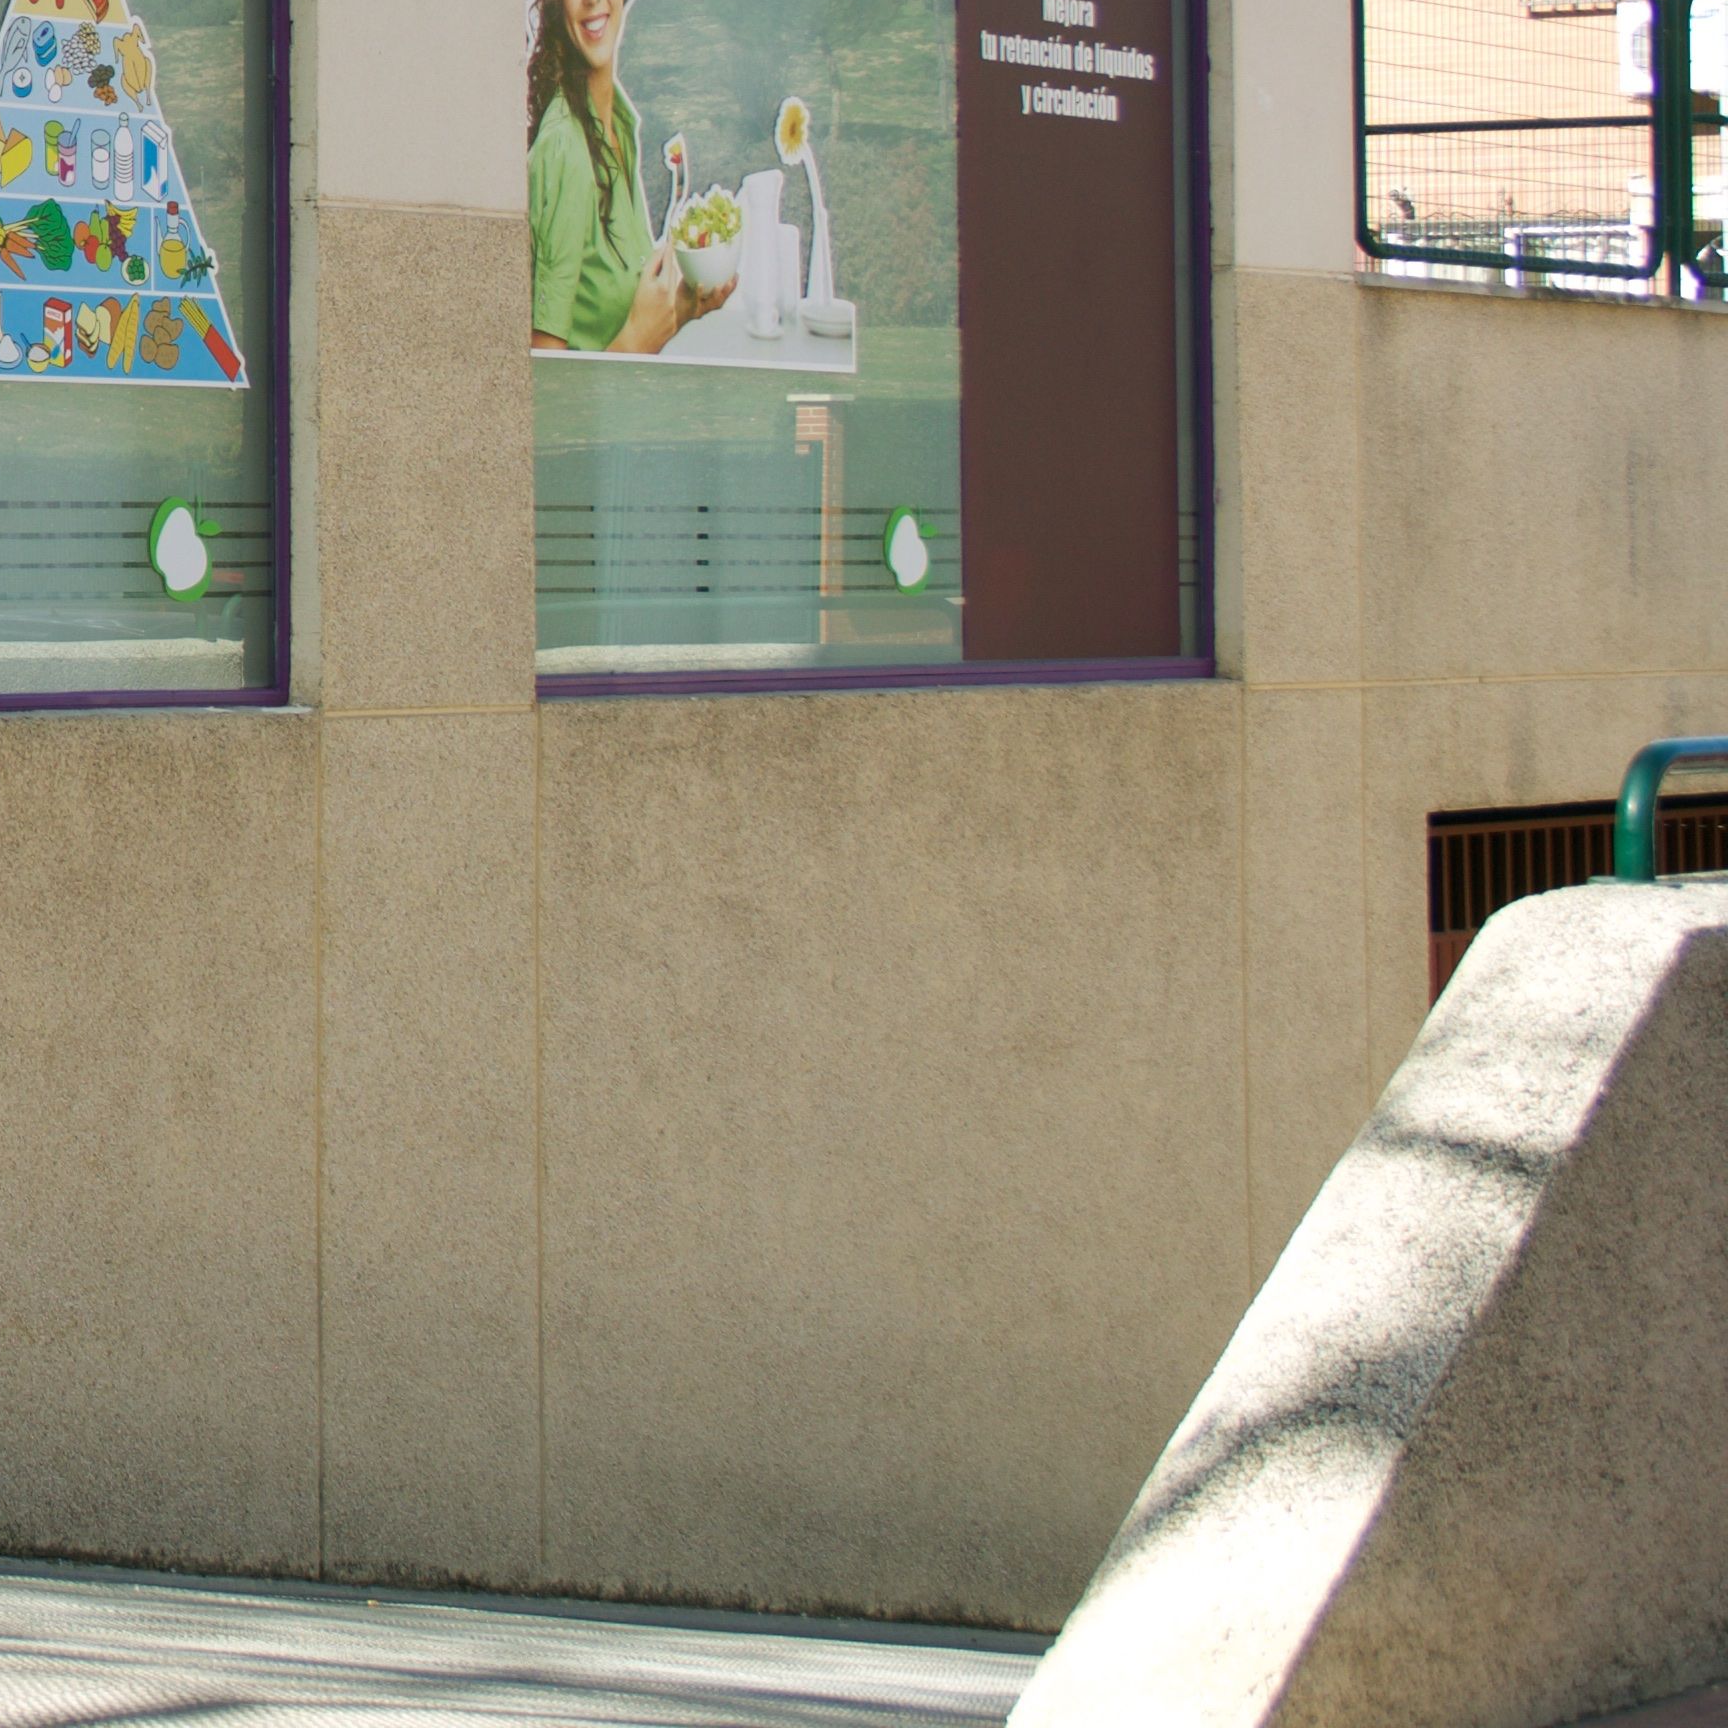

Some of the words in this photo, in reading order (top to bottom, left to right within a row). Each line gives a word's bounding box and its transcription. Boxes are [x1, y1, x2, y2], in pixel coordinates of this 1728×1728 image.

[980, 29, 998, 61] tu
[999, 34, 1073, 71] retención
[1074, 40, 1094, 73] de
[1094, 42, 1155, 81] líquidos
[1020, 83, 1032, 116] y
[1032, 82, 1119, 122] circulación
